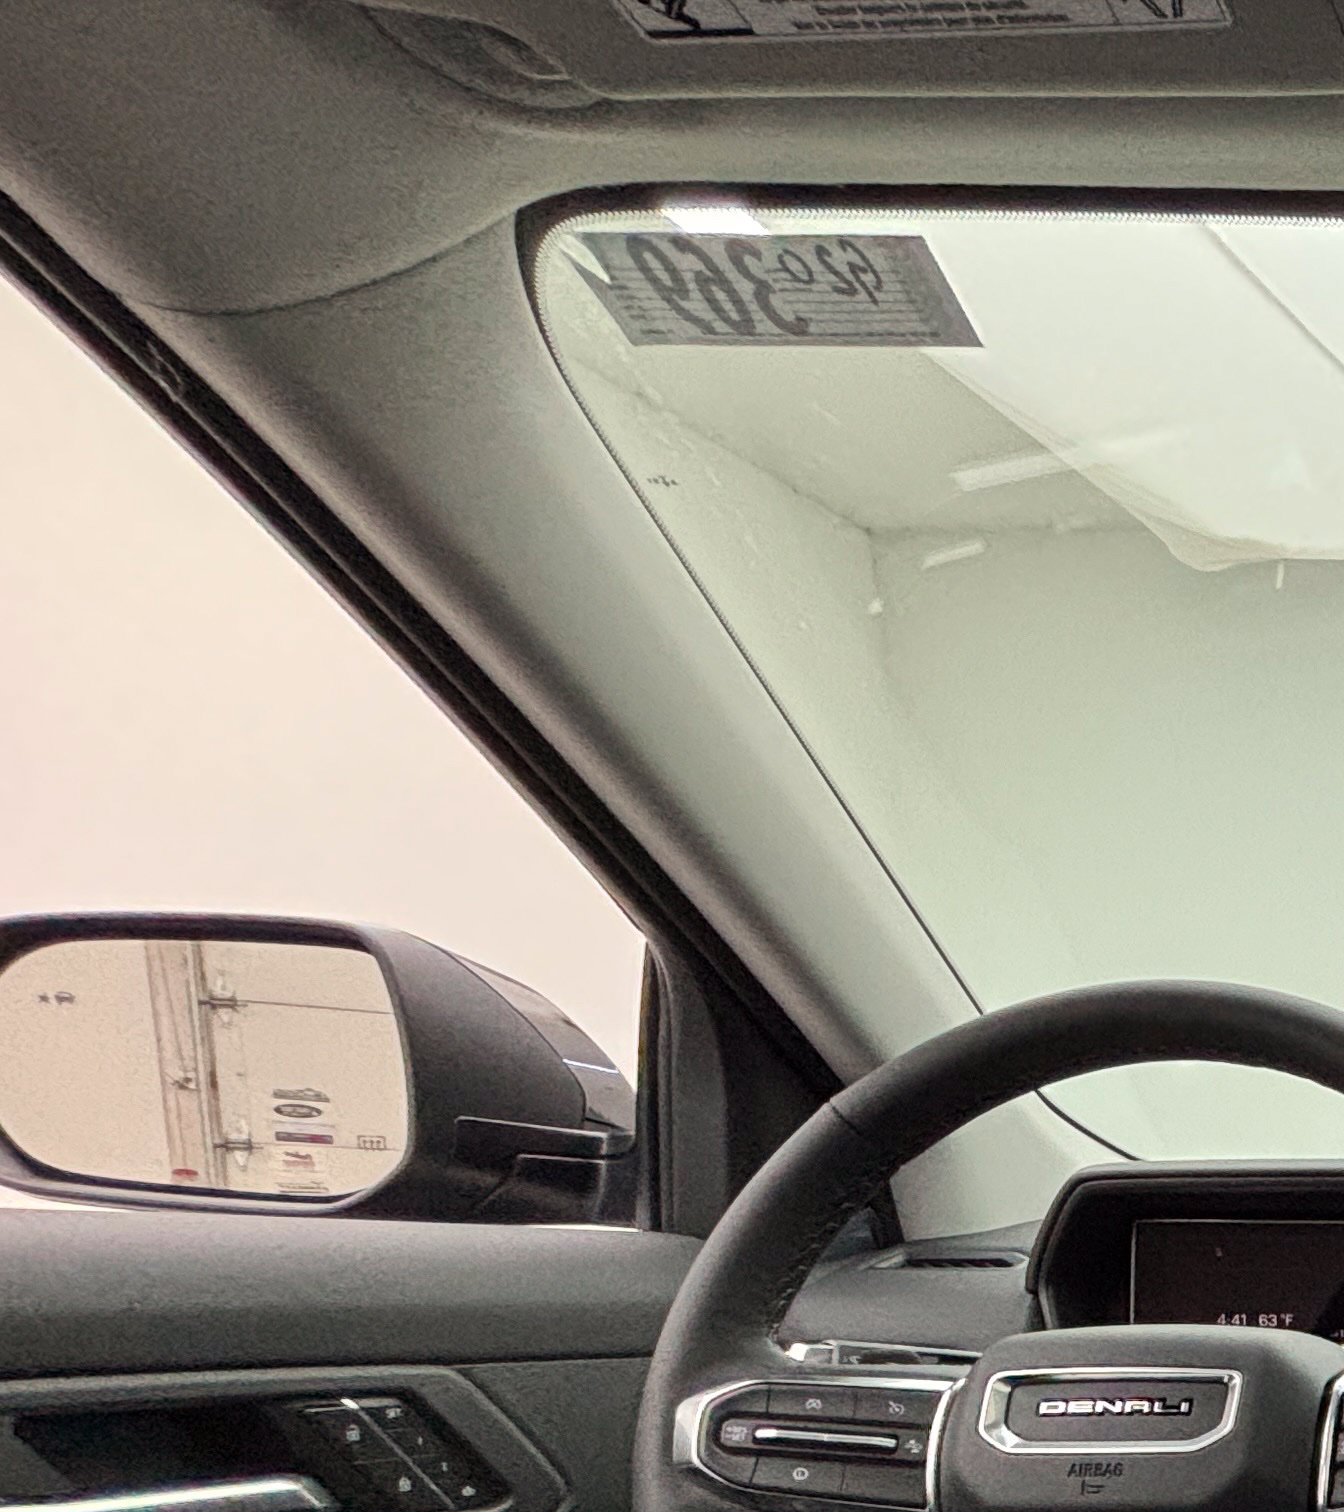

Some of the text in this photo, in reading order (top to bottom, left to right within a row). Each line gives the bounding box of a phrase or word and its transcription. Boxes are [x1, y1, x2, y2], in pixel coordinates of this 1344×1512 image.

[1216, 1314, 1248, 1326] 4:41
[1257, 1314, 1277, 1326] 63
[1038, 1398, 1191, 1416] DENALI
[1067, 1462, 1123, 1478] AIRBAG
